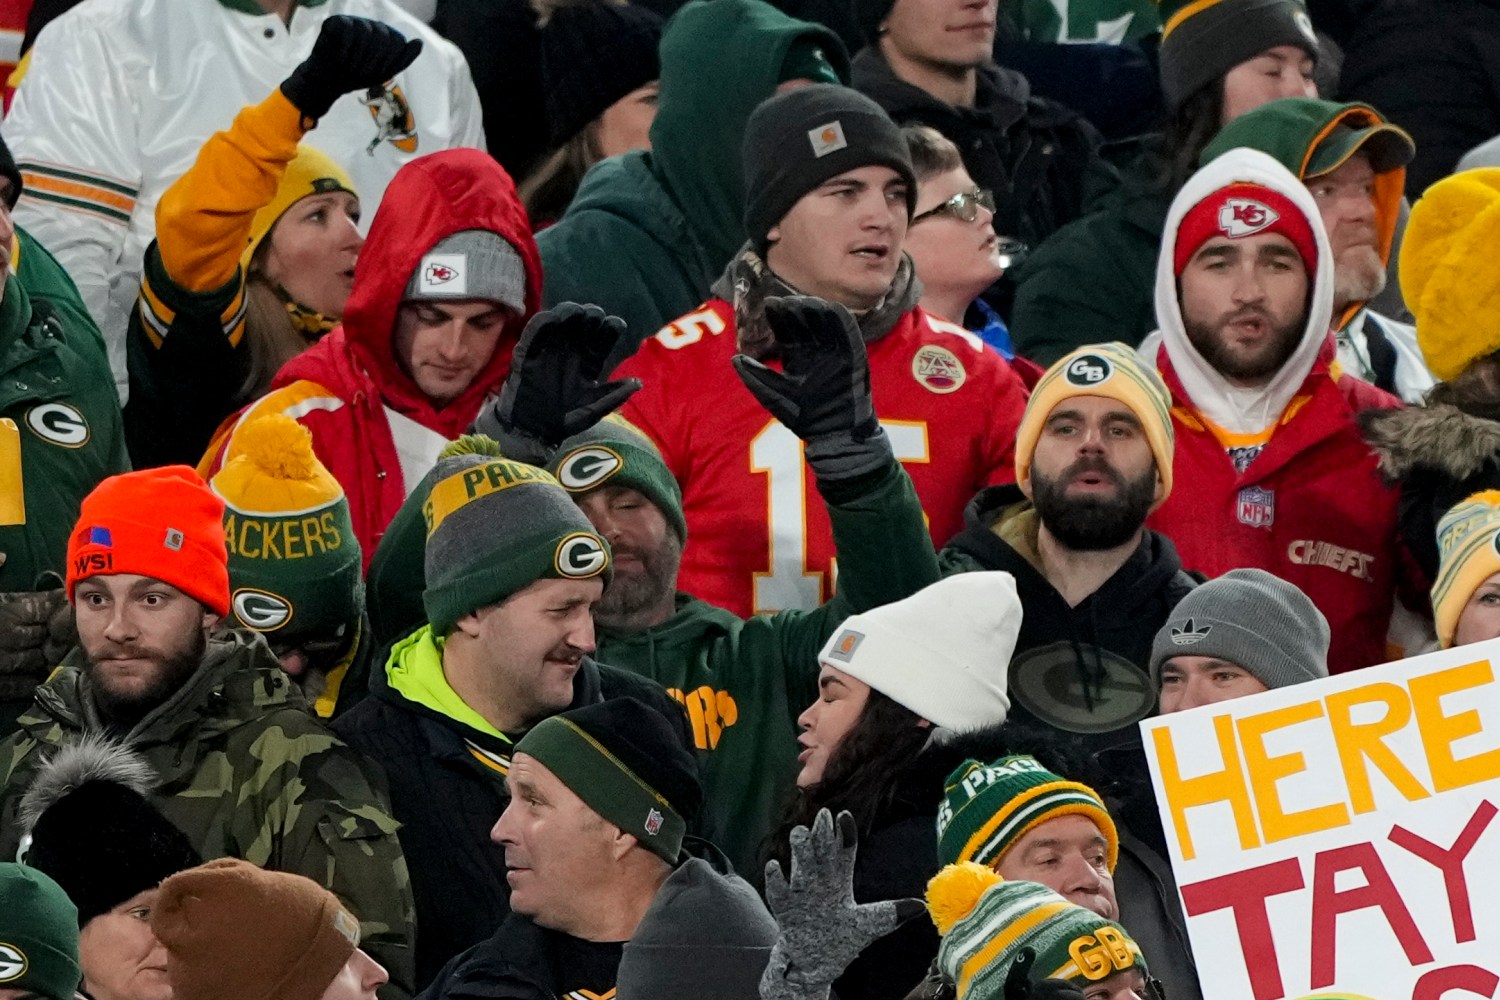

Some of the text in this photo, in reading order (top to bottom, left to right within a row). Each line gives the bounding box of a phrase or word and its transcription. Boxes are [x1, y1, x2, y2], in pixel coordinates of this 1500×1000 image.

[1232, 205, 1266, 226] KC
[1070, 360, 1105, 381] GB
[27, 402, 89, 445] G
[559, 449, 618, 488] G
[74, 553, 112, 573] WSI
[559, 537, 604, 574] G
[1288, 538, 1374, 580] CHIEFS
[234, 592, 289, 627] G
[1058, 926, 1133, 979] GB
